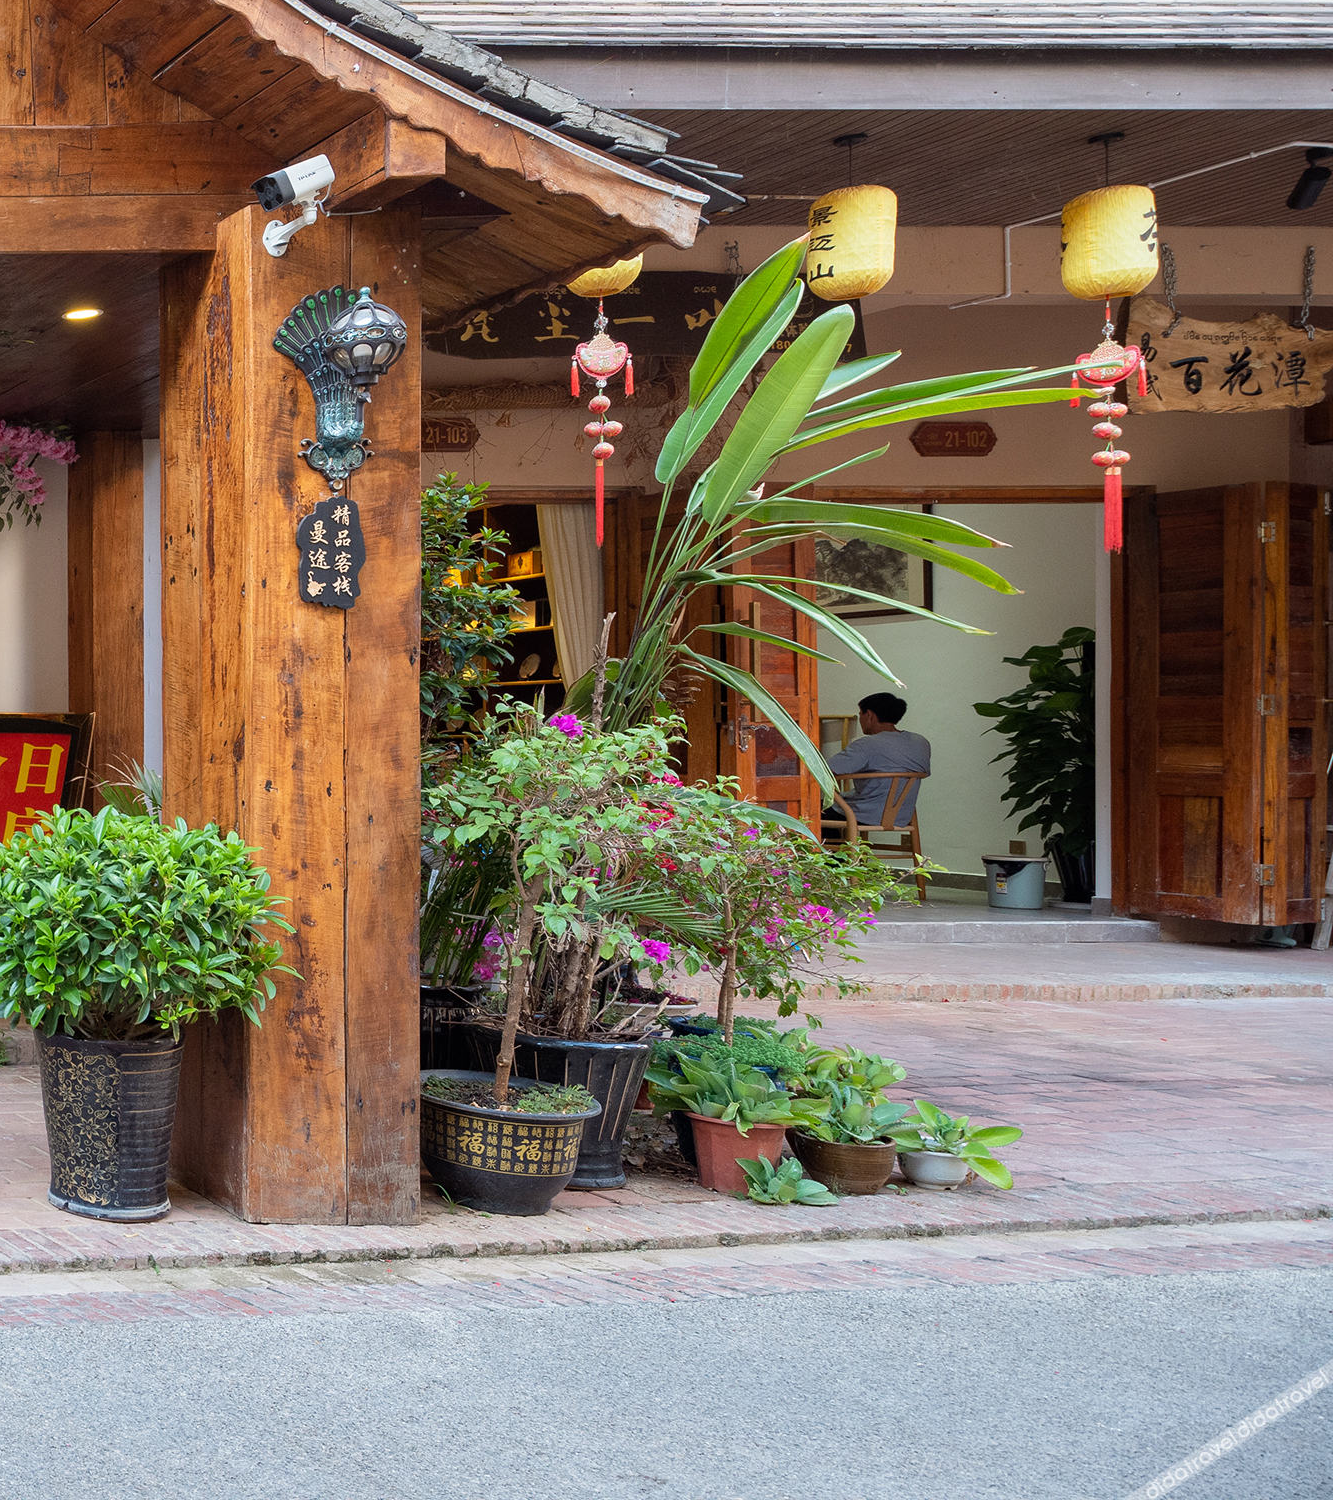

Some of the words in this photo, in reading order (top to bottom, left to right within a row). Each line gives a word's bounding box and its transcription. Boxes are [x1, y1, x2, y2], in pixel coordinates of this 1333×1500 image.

[808, 204, 838, 284] 景迈山
[1168, 346, 1311, 398] 百花潭
[425, 426, 468, 444] 21-103
[944, 430, 988, 448] 21-102
[307, 519, 331, 571] 曼途
[330, 504, 354, 598] 精品客栈
[457, 1129, 486, 1155] 福
[513, 1137, 543, 1162] 福
